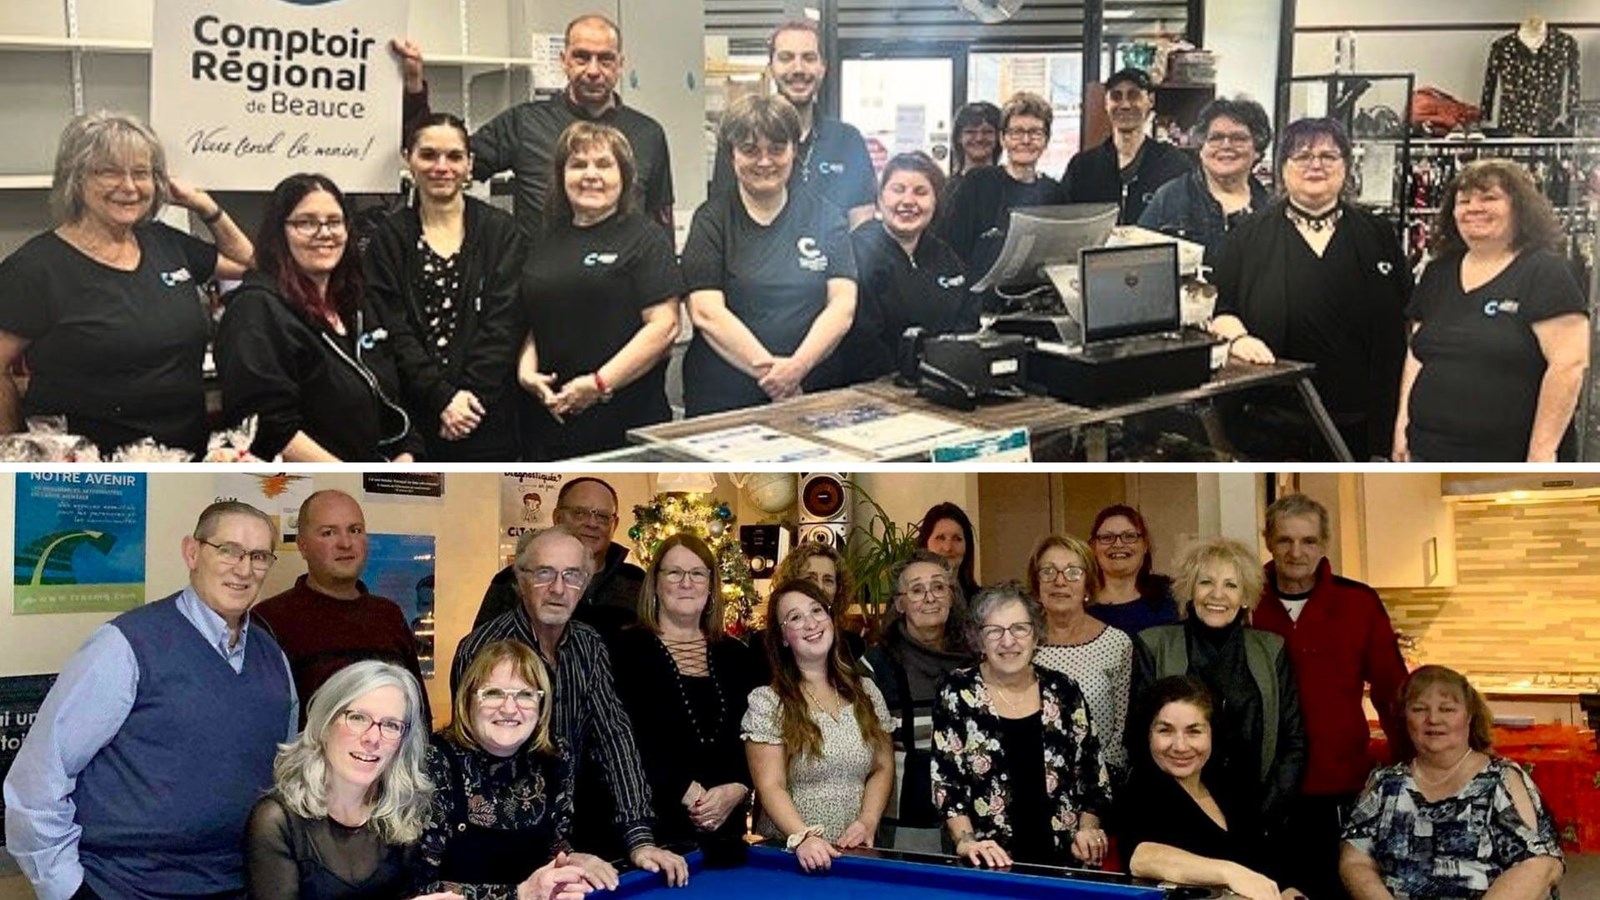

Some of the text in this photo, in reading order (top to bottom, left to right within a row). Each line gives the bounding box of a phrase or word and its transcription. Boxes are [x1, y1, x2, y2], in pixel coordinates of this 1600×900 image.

[193, 15, 376, 61] Comptoir
[191, 50, 367, 92] Régional
[246, 92, 366, 119] de Beauce
[186, 126, 232, 155] Vous
[287, 132, 310, 159] la
[314, 136, 376, 162] main!
[30, 472, 136, 487] NOTRE AVENIR
[1, 733, 26, 751] to
